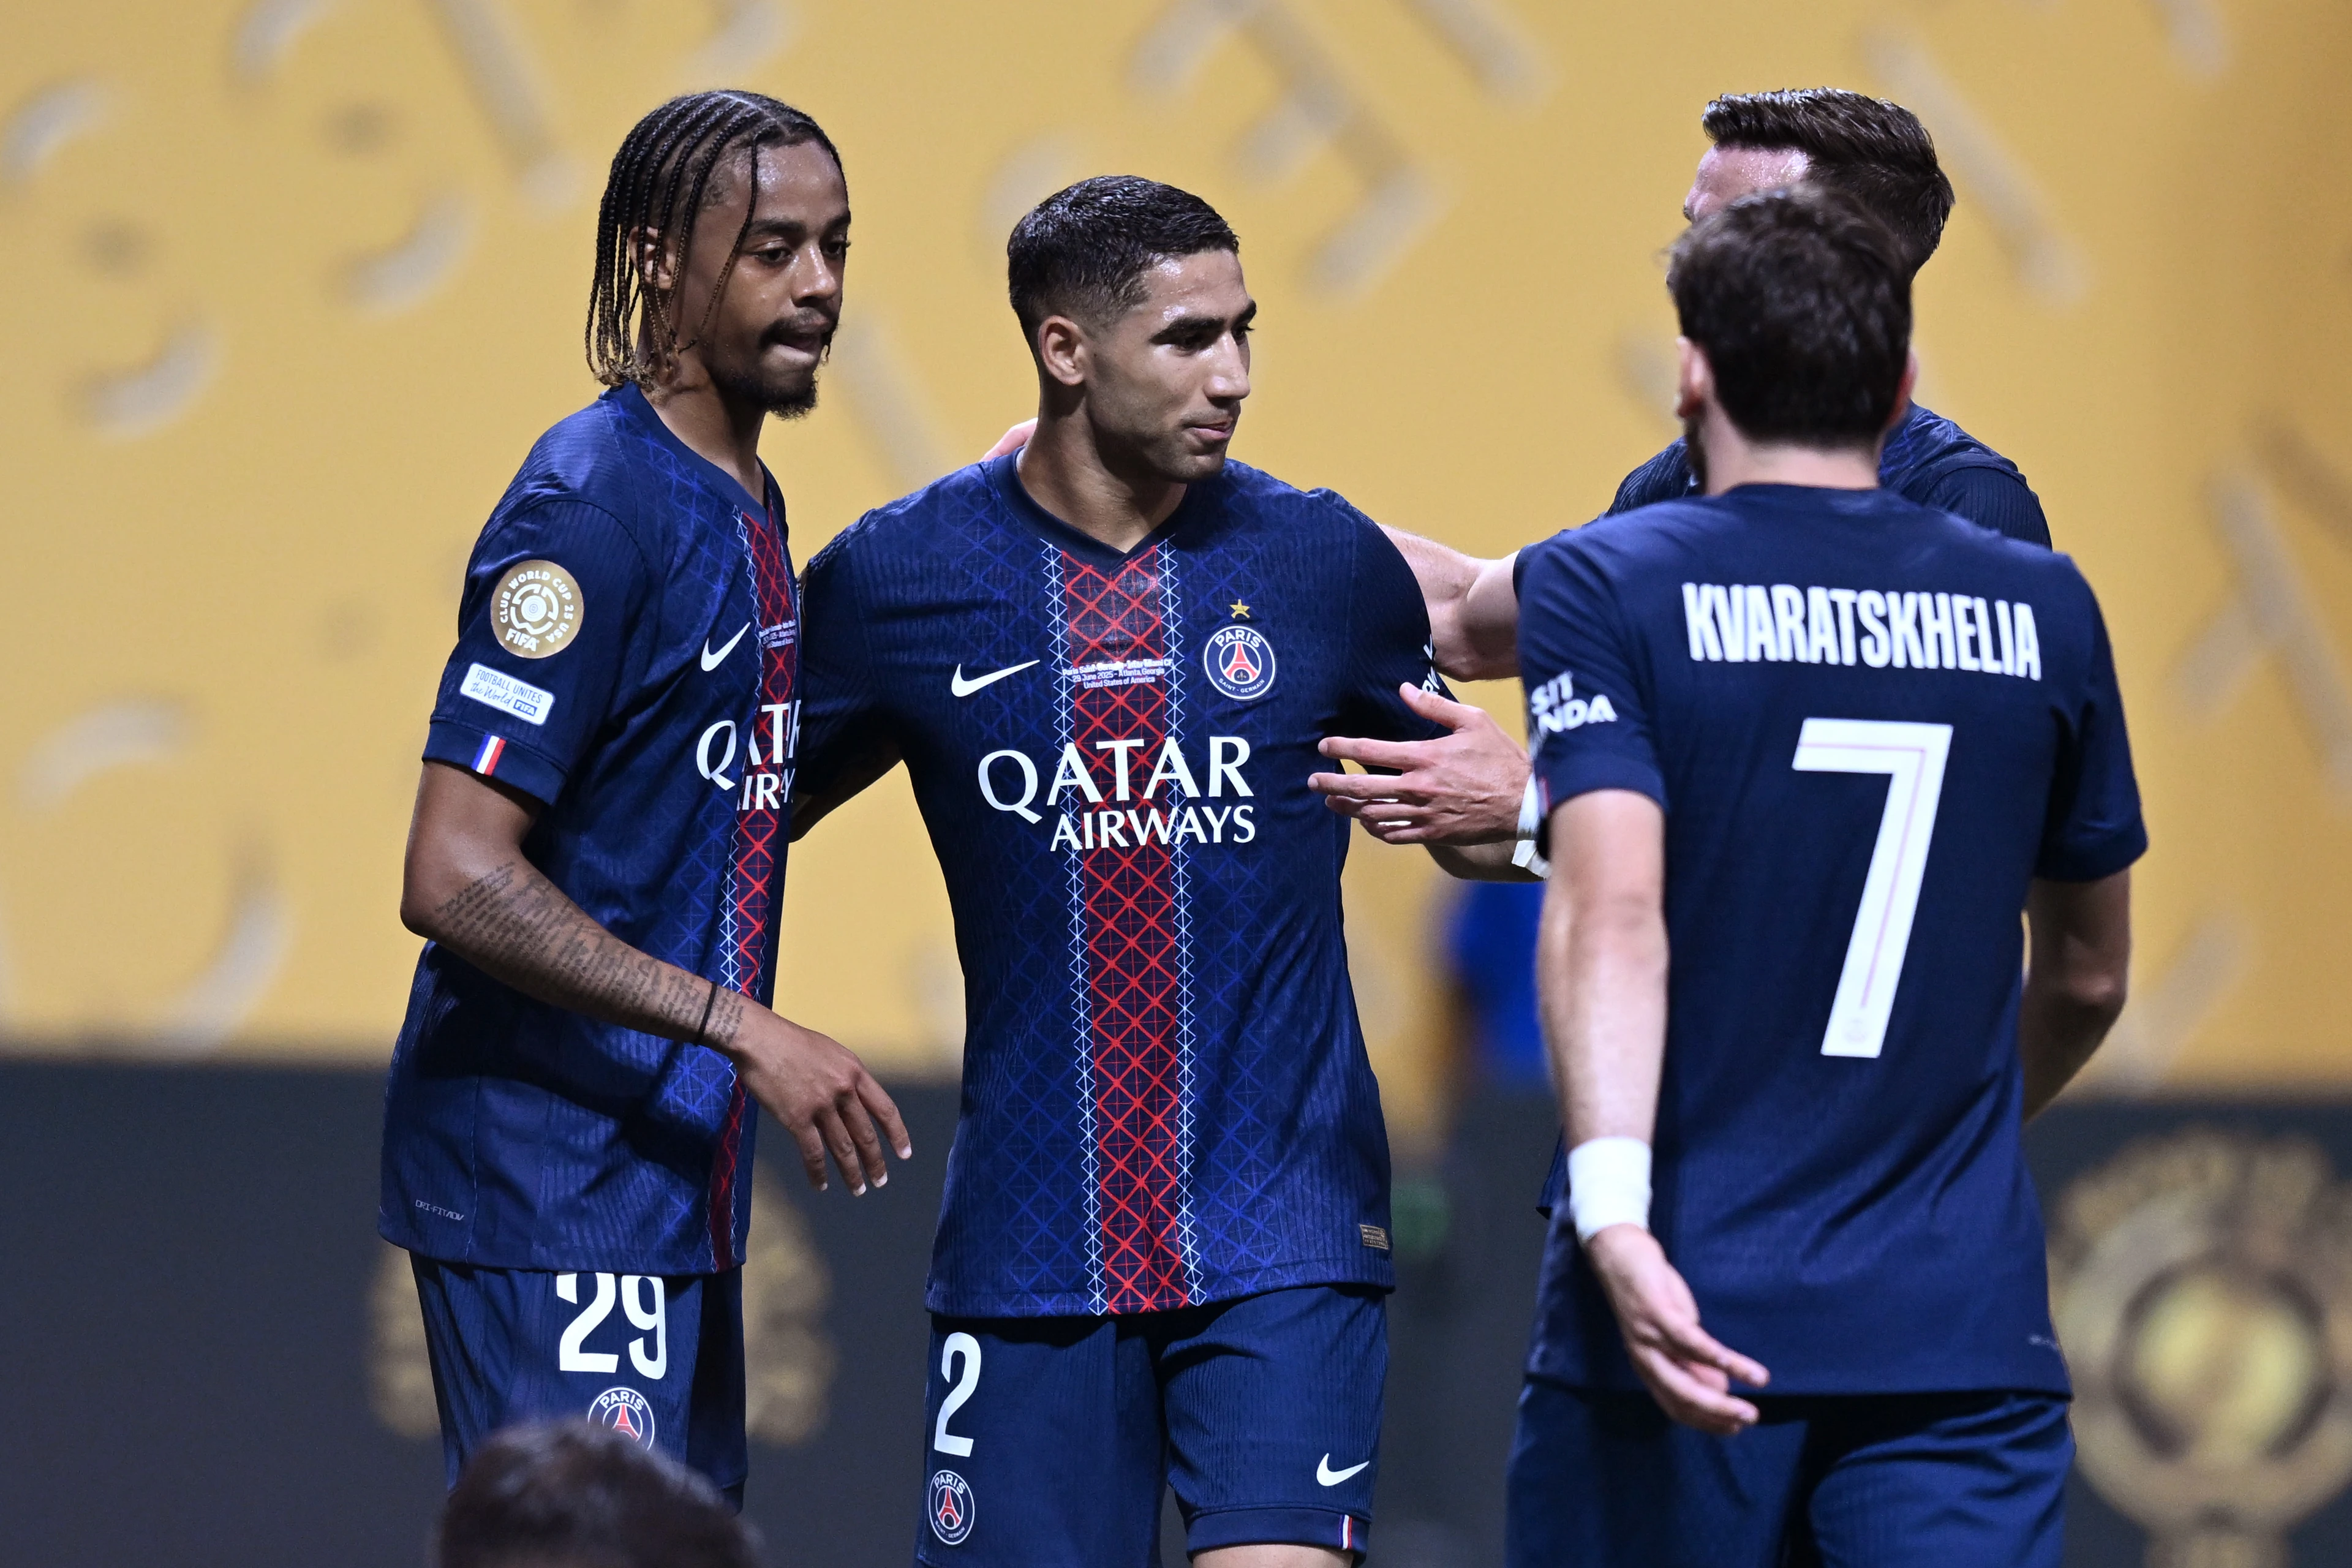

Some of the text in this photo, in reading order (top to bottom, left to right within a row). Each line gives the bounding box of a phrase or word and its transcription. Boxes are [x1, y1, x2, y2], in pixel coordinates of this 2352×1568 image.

[500, 570, 574, 643] CLUB WORLD CUP 25 USA
[505, 628, 537, 652] FIFA
[1215, 630, 1261, 647] PARIS
[1682, 582, 2041, 682] KVARATSKHELIA
[476, 669, 542, 703] FOOTBALL UNITES
[1084, 680, 1103, 689] United
[1104, 678, 1123, 687] States
[1130, 676, 1155, 684] America
[1142, 668, 1165, 676] Georgia
[1531, 671, 1574, 715] SIT
[470, 682, 537, 715] the World FIFA
[1538, 694, 1618, 736] NDA
[979, 736, 1254, 824] QATAR
[1050, 805, 1256, 852] AIRWAYS
[1792, 717, 1953, 1058] 7
[556, 1271, 666, 1380] 29
[600, 1391, 644, 1411] PARIS
[934, 1332, 981, 1457] 2
[934, 1474, 965, 1494] PARIS
